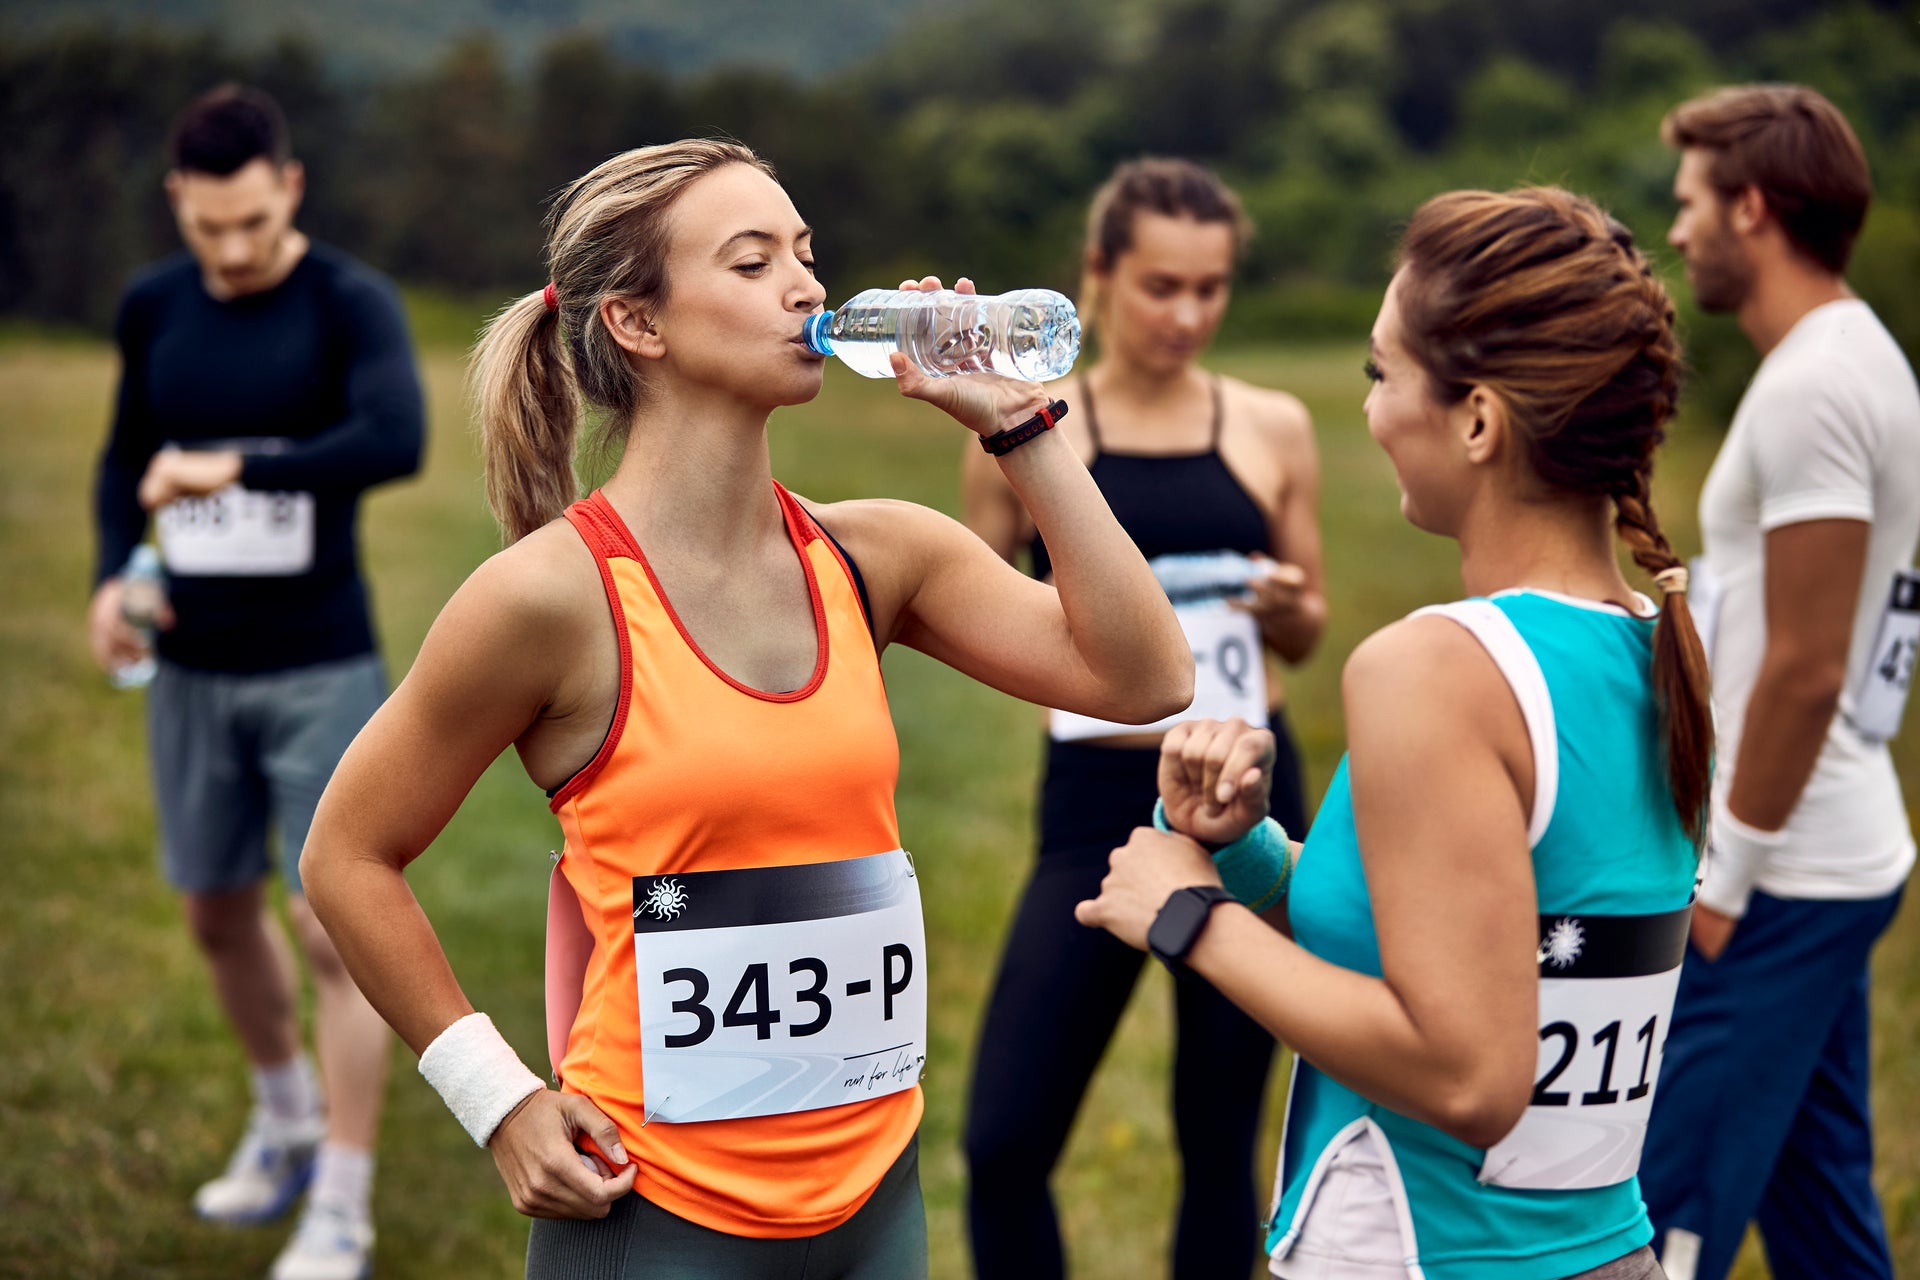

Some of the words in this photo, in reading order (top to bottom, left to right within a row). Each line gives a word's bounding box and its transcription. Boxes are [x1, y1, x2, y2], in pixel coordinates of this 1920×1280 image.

[661, 942, 914, 1049] 343-P
[843, 1074, 865, 1088] run
[867, 1061, 888, 1091] for
[892, 1050, 913, 1083] life
